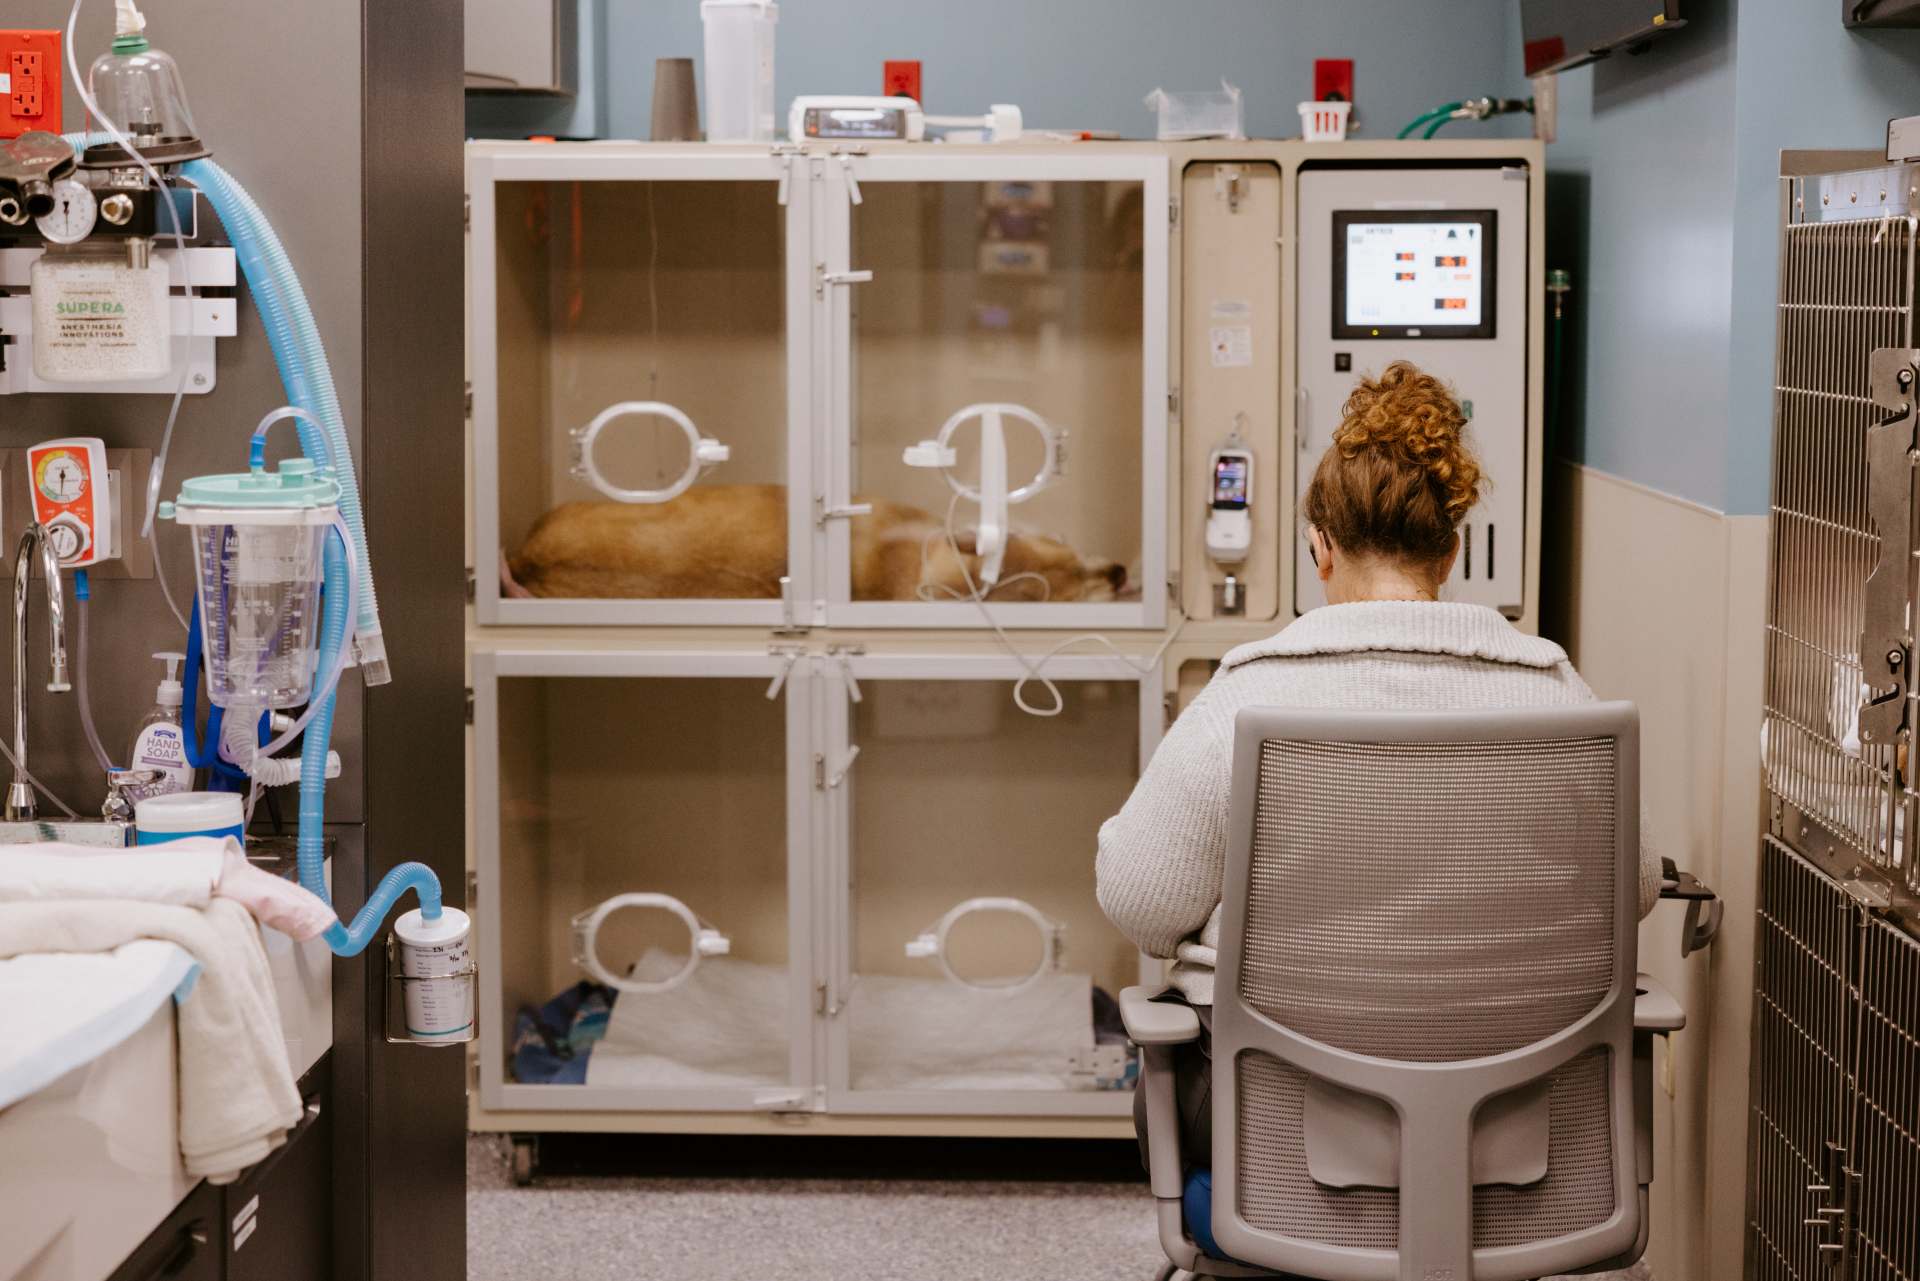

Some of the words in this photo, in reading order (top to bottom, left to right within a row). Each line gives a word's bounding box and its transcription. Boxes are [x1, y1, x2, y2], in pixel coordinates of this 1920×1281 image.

[56, 302, 124, 313] SUPERA
[147, 738, 181, 750] HAND
[147, 747, 178, 759] SOAP
